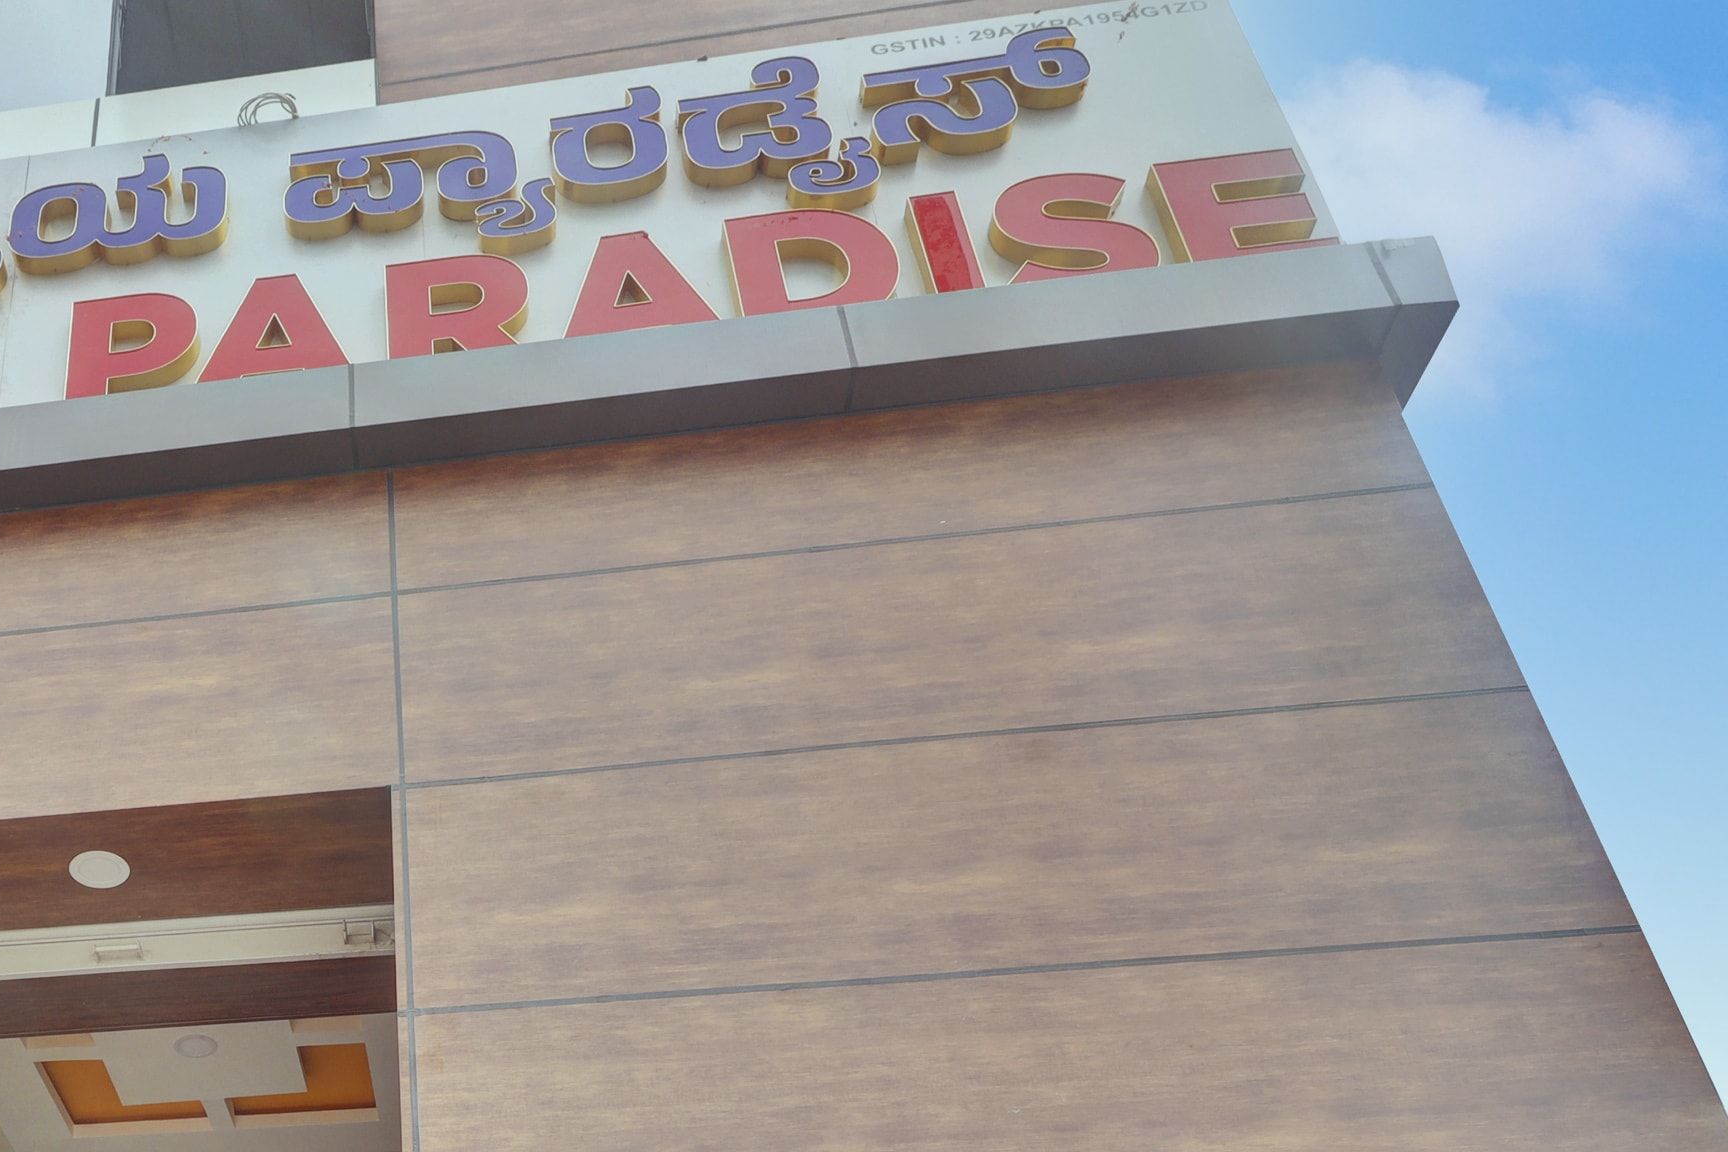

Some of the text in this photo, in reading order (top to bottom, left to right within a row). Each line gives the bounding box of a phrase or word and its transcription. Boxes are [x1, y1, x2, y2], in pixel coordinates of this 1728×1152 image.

[282, 26, 1092, 246] ಪ್ಯಾರಡೈಸ್
[871, 35, 945, 56] GSTIN
[65, 148, 1342, 402] PARADISE
